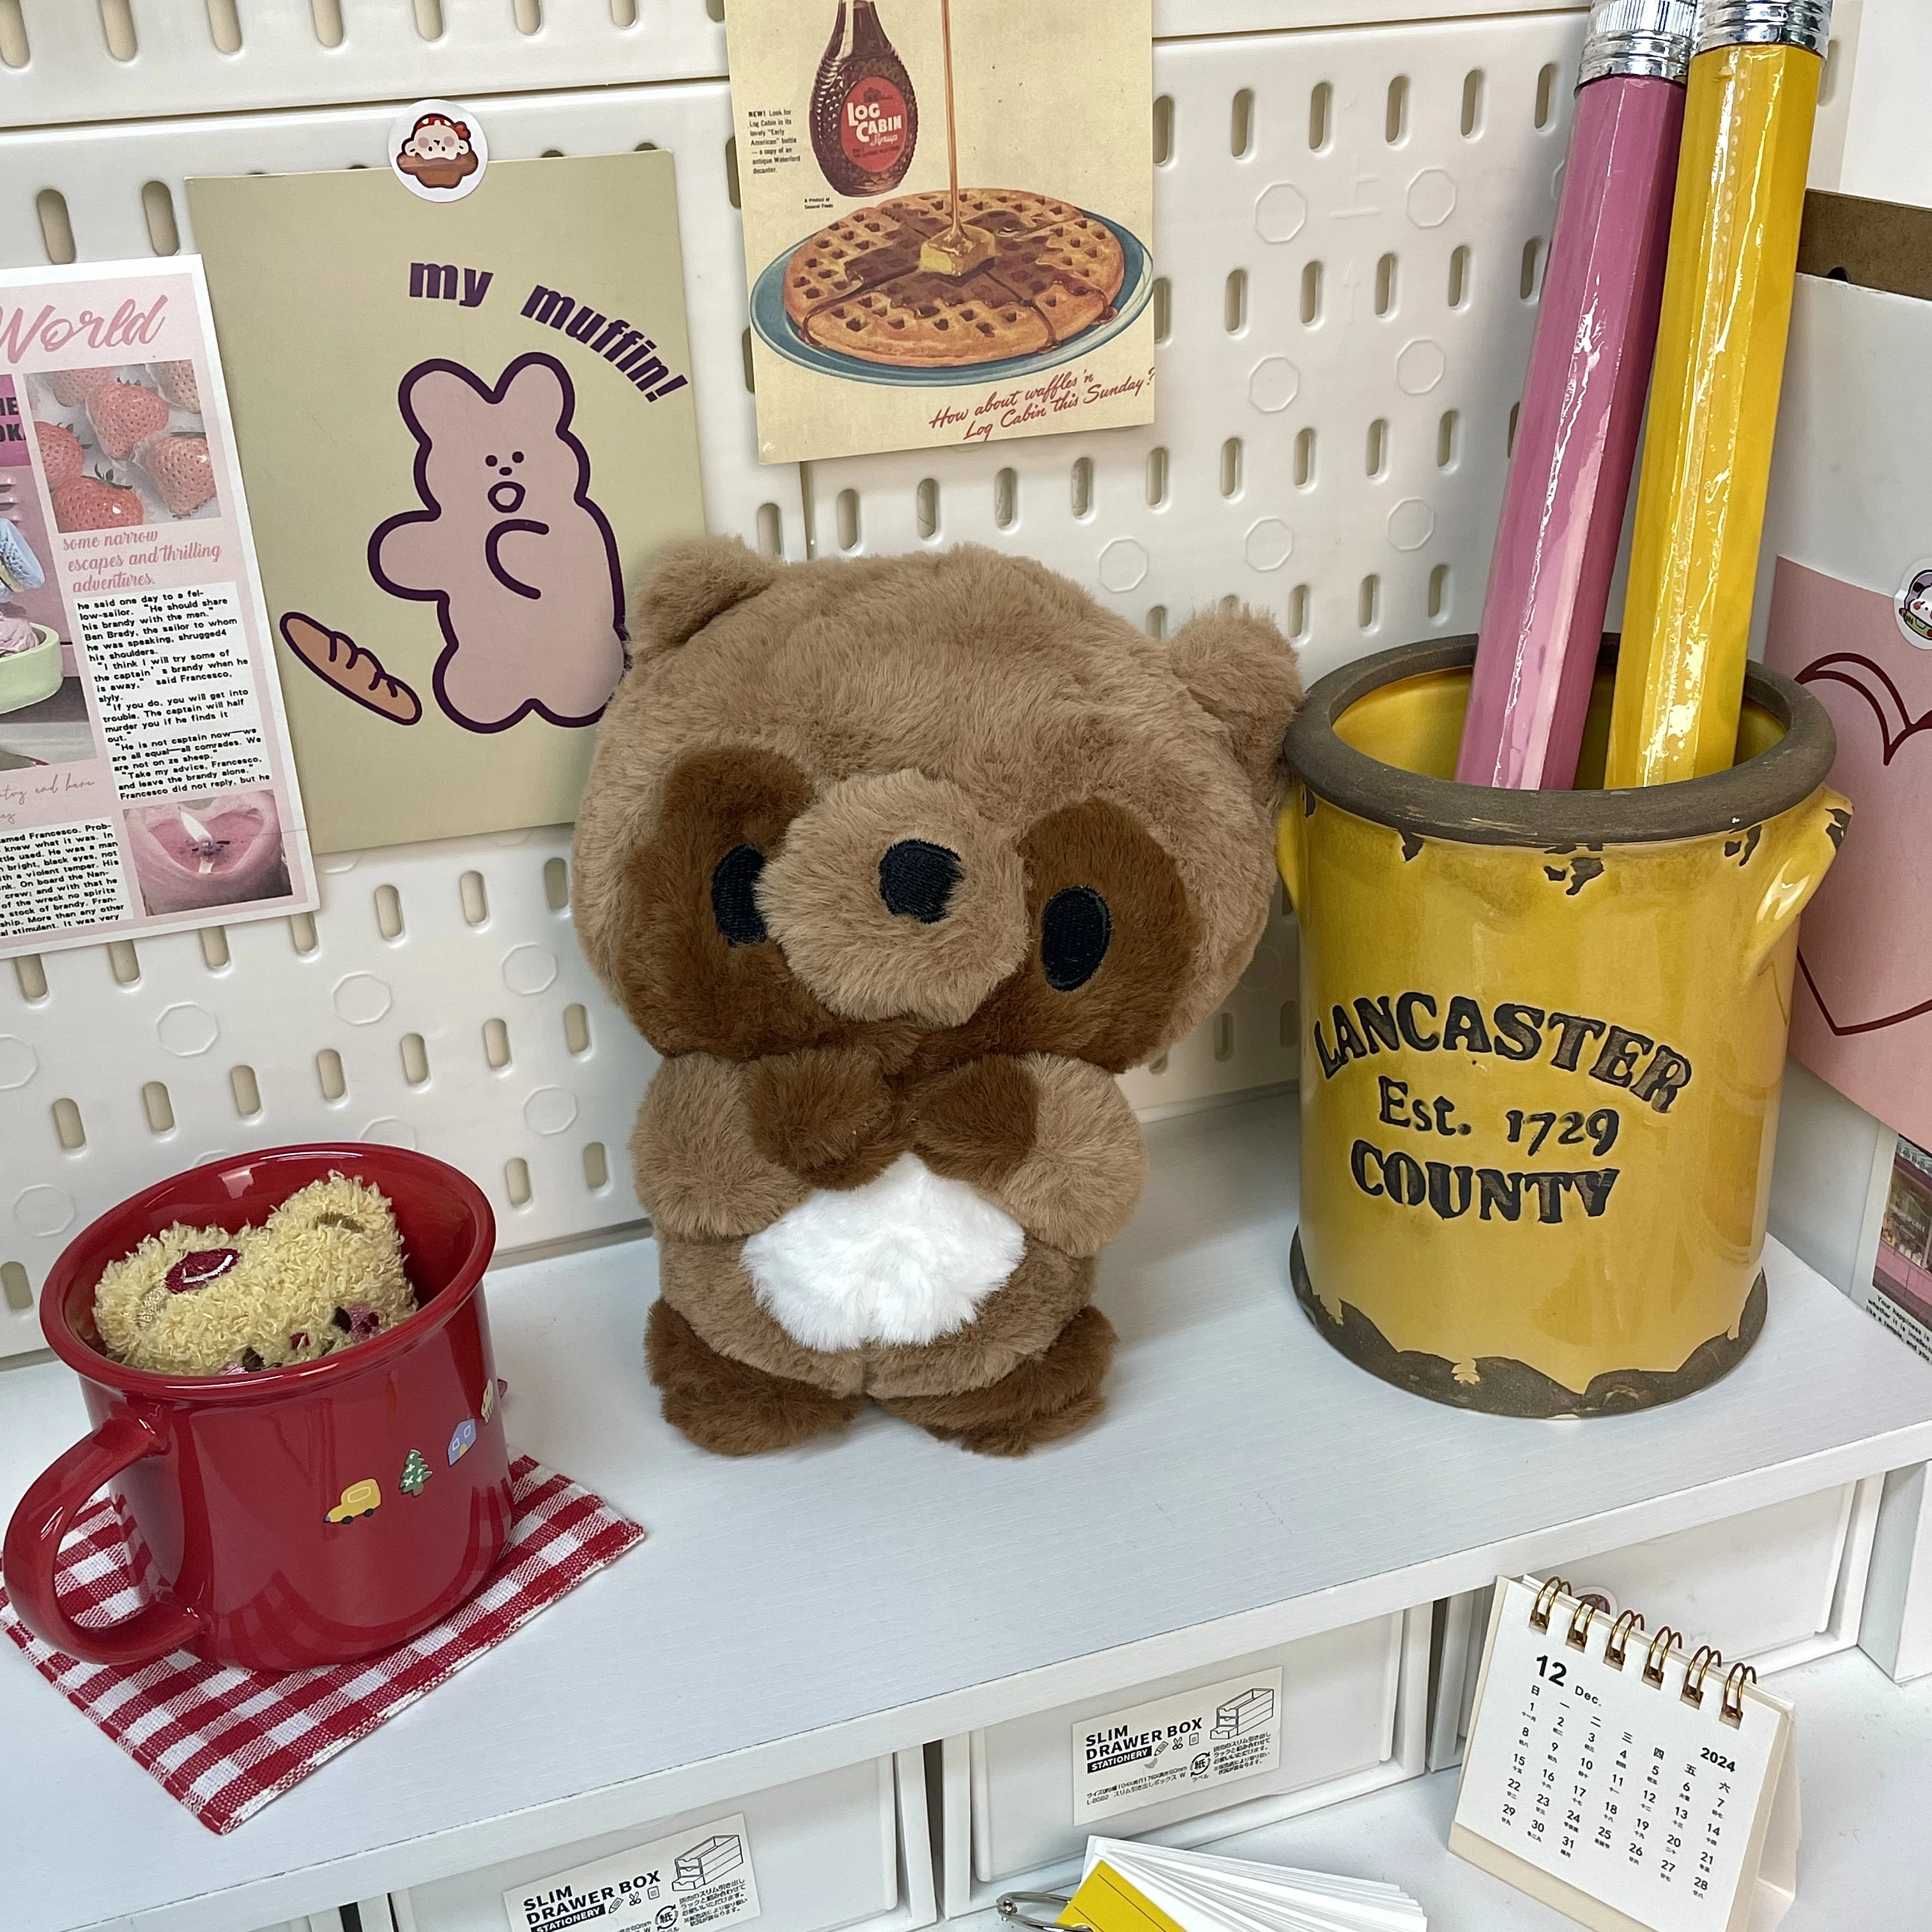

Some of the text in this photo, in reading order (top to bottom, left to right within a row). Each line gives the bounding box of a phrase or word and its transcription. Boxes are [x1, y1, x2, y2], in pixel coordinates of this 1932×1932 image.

[847, 102, 880, 126] LOG
[856, 115, 902, 142] CABIN
[870, 133, 898, 146] Syrup
[408, 262, 689, 404] my muffin!
[929, 406, 969, 429] How
[975, 390, 1023, 417] about
[1025, 371, 1078, 403] waffles
[963, 419, 993, 441] Log
[1000, 404, 1046, 428] Cabin
[1050, 392, 1078, 413] this
[63, 530, 158, 551] some narrow
[68, 542, 222, 575] escapes and thrilling
[73, 571, 156, 593] adventures.
[77, 602, 89, 610] he
[94, 599, 116, 609] said
[119, 597, 137, 606] one
[141, 595, 158, 604] day
[187, 589, 204, 597] fel-
[79, 608, 135, 621] low-sailor.
[167, 601, 199, 611] should
[202, 598, 228, 607] share
[82, 622, 98, 631] his
[102, 619, 135, 630] brandy
[139, 615, 164, 625] with
[167, 612, 183, 622] the
[84, 633, 103, 641] Ben
[143, 626, 159, 635] the
[162, 623, 190, 633] sailor
[208, 618, 238, 627] whom
[87, 643, 100, 652] he
[89, 647, 159, 663] his shoulders.
[119, 787, 169, 801] Francesco
[172, 784, 188, 793] did
[191, 782, 207, 791] not
[240, 776, 256, 785] but
[259, 773, 270, 781] he
[4, 844, 31, 853] knew
[35, 839, 59, 848] what
[75, 835, 99, 843] was.
[1314, 992, 1692, 1113] LANCASTER
[1378, 1075, 1620, 1156] Est. 1729
[1350, 1139, 1620, 1223] COUNTY
[1536, 1655, 1602, 1706] 12 Dec.
[1086, 1724, 1128, 1747] SLIM
[1086, 1717, 1202, 1760] DRAWER BOX
[1531, 1685, 1540, 1696] 日
[1590, 1716, 1601, 1728] 二
[1621, 1731, 1633, 1744] 三
[1653, 1747, 1665, 1760] 四
[1684, 1763, 1697, 1777] 五
[1718, 1782, 1731, 1794] 六
[1091, 1749, 1148, 1771] STATIONERY
[1194, 1759, 1206, 1770] 紙
[1530, 1702, 1725, 1807] 1 2 3 4 5 6 7
[1700, 1747, 1735, 1773] 2024
[1522, 1727, 1720, 1836] 8 9 10 11 12 13 14
[1514, 1753, 1713, 1865] 15 16 17 18 19 20 21
[1502, 1804, 1574, 1849] 29 30 31
[1507, 1778, 1708, 1890] 22 23 24 25 26 27 28
[523, 1885, 572, 1912] SLIM
[527, 1870, 662, 1926] DRAWER BOX
[536, 1906, 601, 1932] STATIONERY
